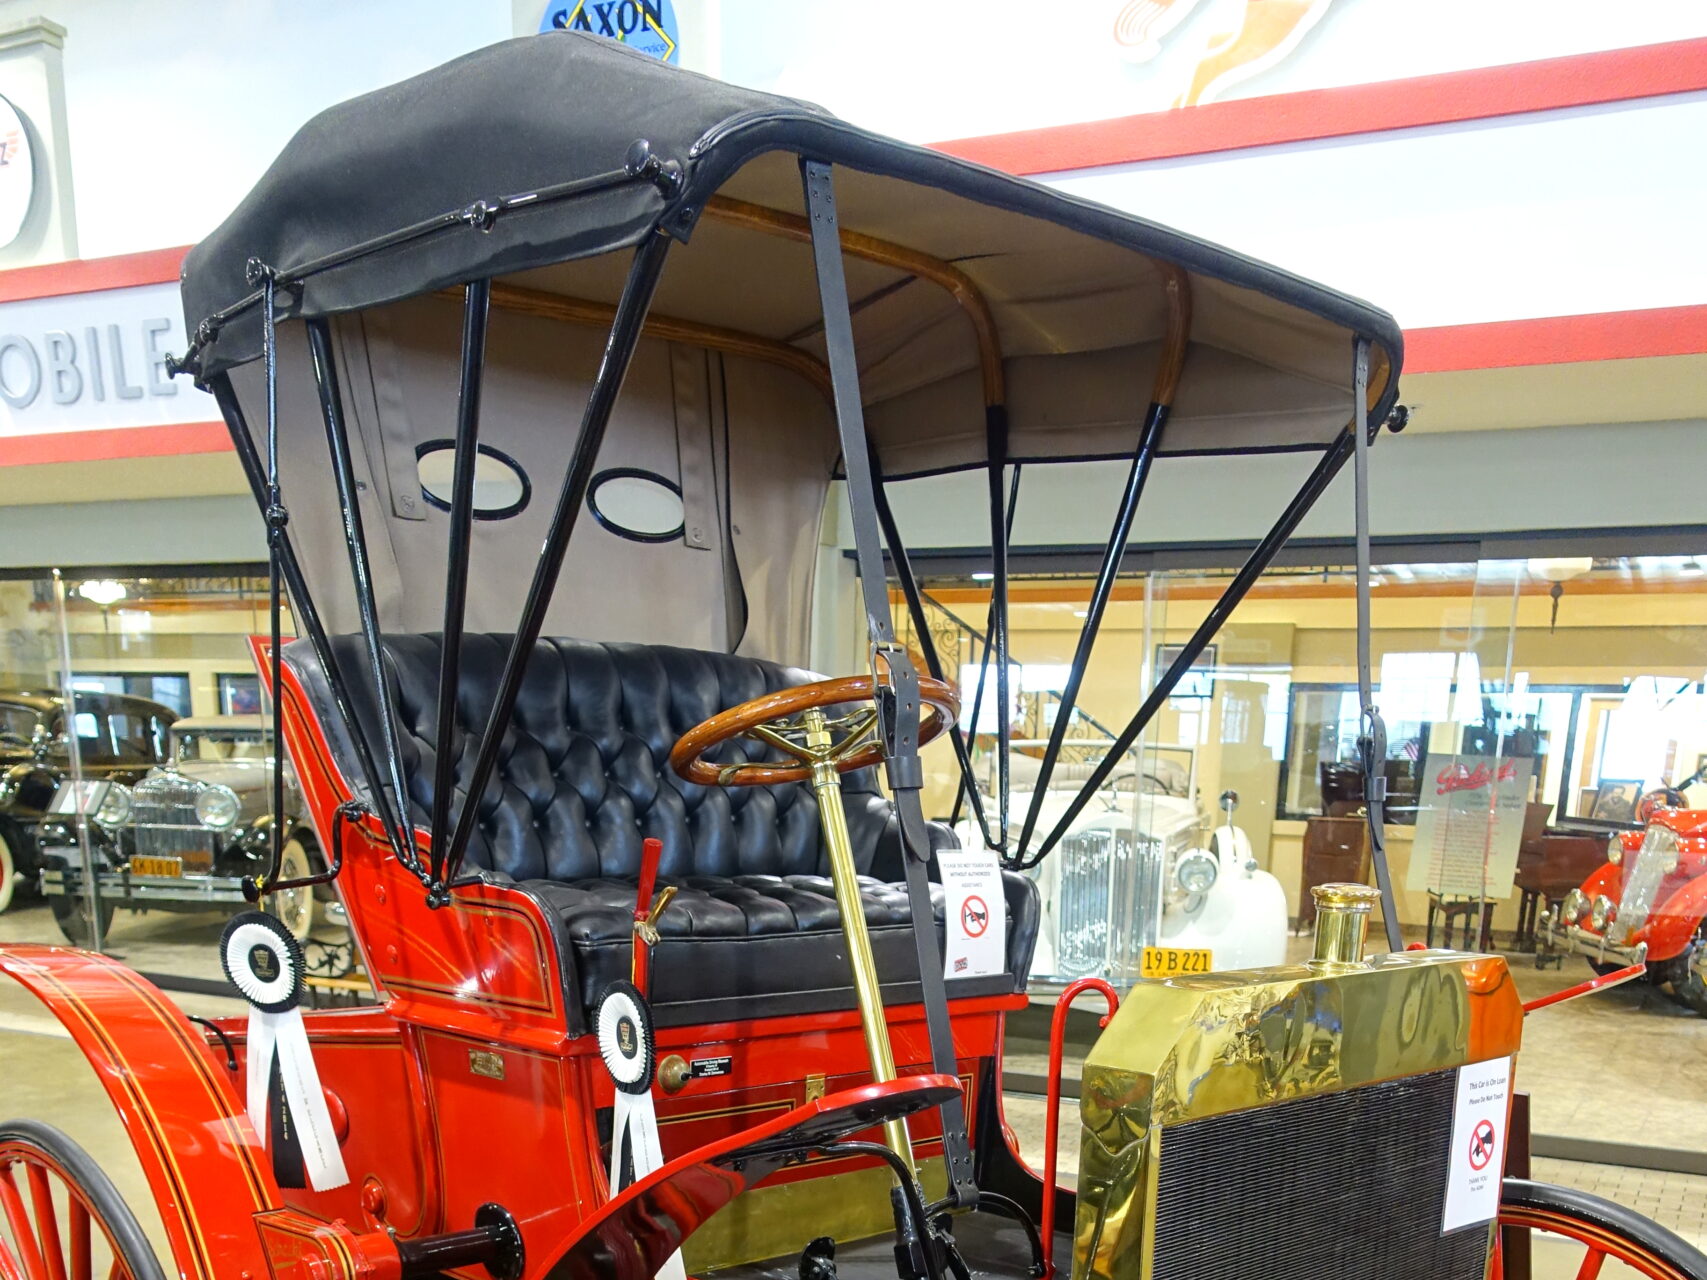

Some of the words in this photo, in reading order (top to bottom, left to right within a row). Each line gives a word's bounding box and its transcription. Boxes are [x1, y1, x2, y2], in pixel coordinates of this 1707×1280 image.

[552, 0, 663, 37] SAXON
[1145, 951, 1163, 970] 19
[1167, 951, 1178, 970] B
[1182, 952, 1209, 972] 221
